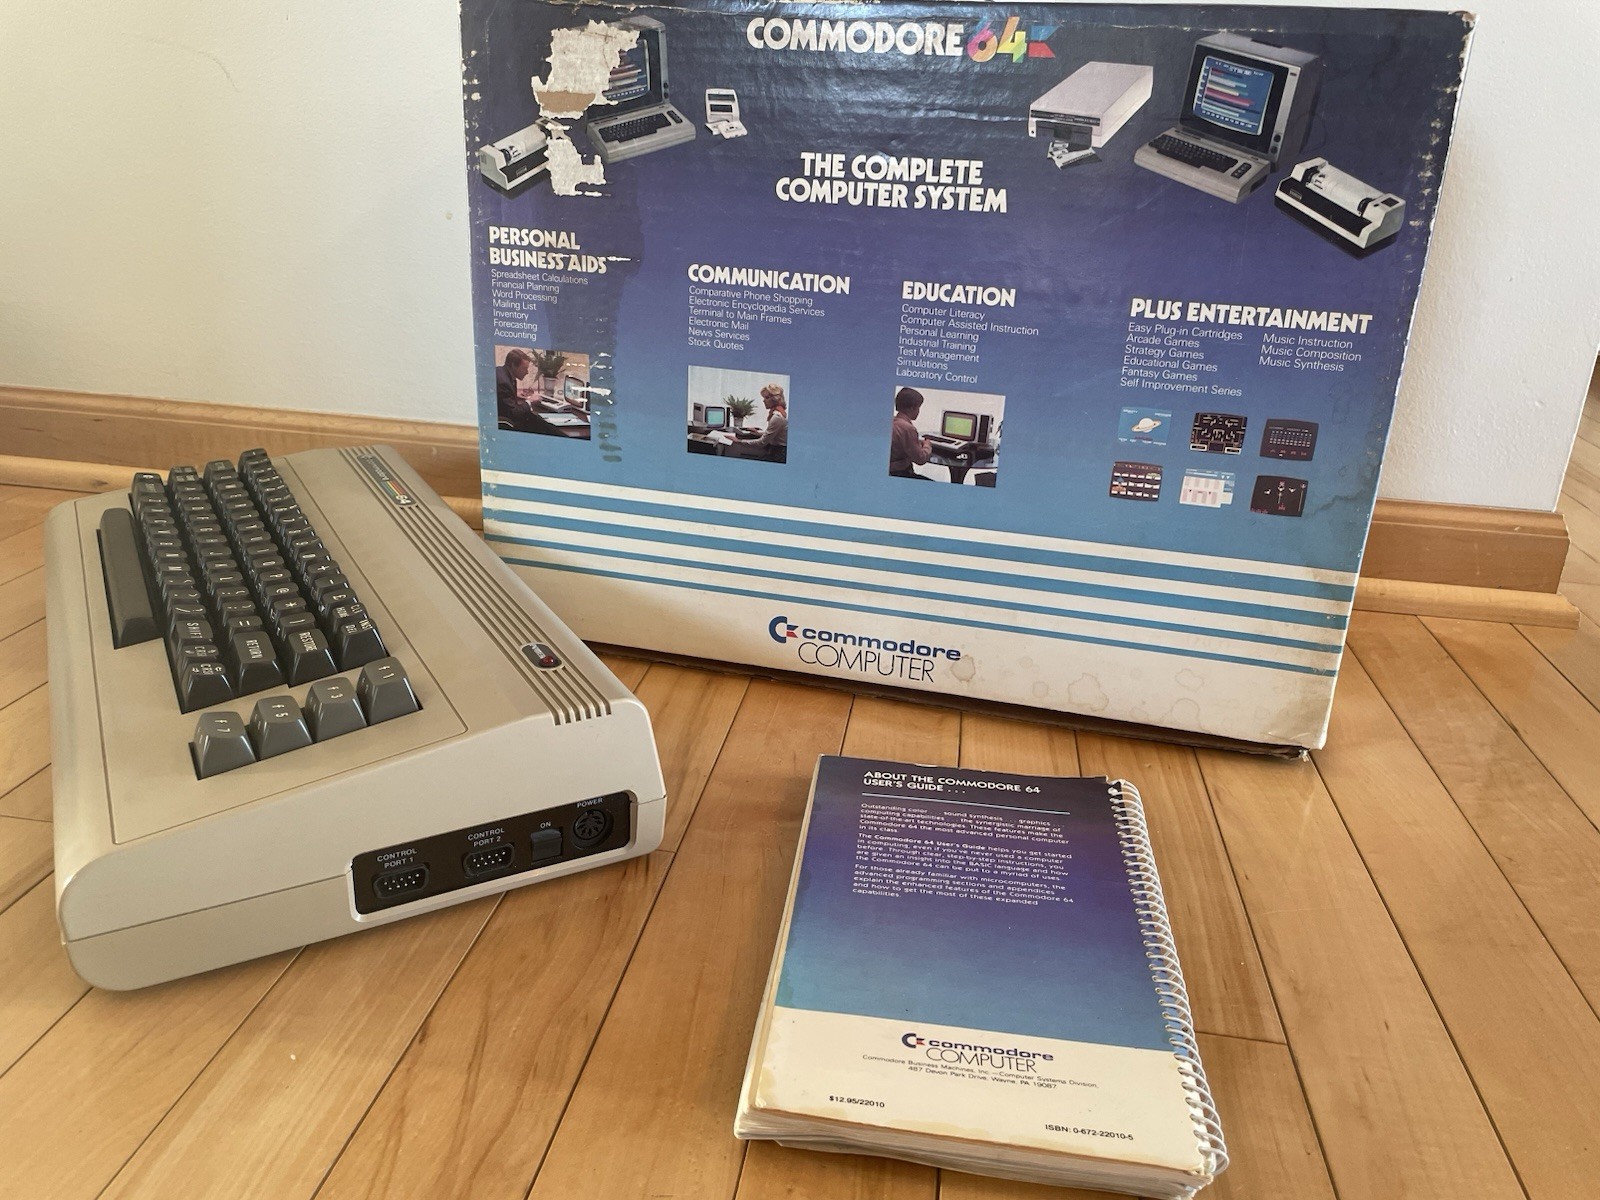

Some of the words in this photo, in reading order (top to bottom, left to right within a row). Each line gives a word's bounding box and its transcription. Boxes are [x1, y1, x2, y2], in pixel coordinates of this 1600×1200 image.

[746, 17, 964, 57] COMMODORE
[966, 16, 1027, 64] 64
[800, 152, 845, 178] THE
[851, 155, 984, 186] COMPLETE
[775, 177, 908, 209] COMPUTER
[913, 185, 1008, 213] SYSTEM
[489, 226, 580, 250] PERSONAL
[489, 248, 564, 270] BUSINESS
[567, 254, 607, 274] AIDS
[491, 269, 540, 281] Spreadsheet
[542, 273, 588, 285] Calculations
[688, 263, 850, 295] COMMUNICATION
[491, 279, 525, 289] Financial
[527, 283, 560, 294] Planning
[902, 281, 1016, 307] EDUCATION
[492, 289, 513, 299] Word
[516, 291, 557, 304] Processing
[493, 299, 520, 310] Mailing
[522, 301, 537, 310] List
[689, 285, 741, 299] Comparative
[744, 290, 771, 302] Phone
[773, 293, 813, 307] Shopping
[493, 309, 529, 320] Inventory
[689, 296, 729, 308] Electronic
[732, 301, 786, 314] Encyclopedia
[789, 306, 825, 317] Services
[901, 303, 947, 316] Computer
[949, 308, 985, 321] Literacy
[689, 306, 723, 318] Terminal
[726, 310, 734, 319] to
[737, 311, 757, 321] Main
[760, 314, 792, 325] Frames
[689, 317, 728, 328] Electronic
[731, 321, 749, 330] Mail
[1130, 298, 1183, 321] PLUS
[1186, 302, 1373, 334] ENTERTAINMENT
[493, 319, 538, 331] Forecasting
[900, 325, 938, 337] Personal
[940, 329, 979, 342] Learning
[901, 314, 945, 327] Computer
[948, 319, 987, 331] Assisted
[990, 323, 1039, 336] Instruction
[1128, 322, 1152, 334] Easy
[1155, 324, 1188, 337] Plug-in
[1191, 327, 1243, 341] Cartridges
[494, 328, 537, 341] Accounting
[688, 327, 712, 338] News
[715, 330, 750, 341] Services
[1126, 333, 1161, 345] Arcade
[1164, 336, 1200, 348] Games
[1263, 333, 1295, 345] Music
[1298, 336, 1353, 349] Instruction
[688, 337, 711, 347] Stock
[714, 340, 744, 351] Quotes
[899, 336, 939, 348] Industrial
[941, 339, 977, 353] Training
[1125, 344, 1166, 358] Strategy
[1168, 347, 1205, 359] Games
[1261, 344, 1293, 357] Music
[1296, 347, 1361, 361] Composition
[898, 346, 917, 356] Test
[919, 348, 979, 362] Management
[897, 357, 948, 370] Simulations
[1123, 355, 1180, 369] Educational
[1182, 360, 1218, 372] Games
[1259, 356, 1291, 368] Music
[1293, 358, 1344, 372] Synthesis
[896, 367, 942, 381] Laboratory
[945, 372, 978, 384] Control
[1121, 366, 1159, 380] Fantasy
[1162, 369, 1198, 381] Games
[1120, 377, 1140, 387] Self
[1142, 379, 1208, 394] Improvement
[1211, 384, 1242, 397] Series
[802, 628, 961, 661] commodore
[798, 641, 935, 683] COMPUTER
[863, 778, 903, 788] USER'S
[907, 781, 944, 791] GUIDE
[864, 771, 907, 781] ABOUT
[911, 774, 934, 784] THE
[938, 777, 1021, 792] COMMODORE
[1025, 785, 1041, 794] 64
[576, 797, 603, 808] POWER
[861, 803, 907, 812] Outstanding
[969, 813, 1003, 821] synthesis
[1018, 819, 1051, 827] graphics
[540, 821, 552, 829] ON
[860, 818, 906, 829] Commodore
[956, 829, 993, 838] advanced
[996, 833, 1029, 842] personal
[1032, 836, 1069, 845] computer
[467, 828, 505, 841] CONTROL
[473, 838, 493, 848] PORT
[874, 834, 922, 845] Commodore
[988, 845, 1010, 853] helps
[376, 848, 418, 862] CONTROL
[384, 858, 406, 869] PORT
[854, 870, 894, 879] advanced
[896, 874, 951, 885] programming
[952, 880, 986, 888] sections
[1006, 885, 1055, 895] appendices
[895, 868, 926, 876] already
[927, 871, 957, 879] familiar
[960, 873, 978, 881] with
[929, 1040, 1054, 1061] commodore
[862, 1054, 906, 1064] Commodore
[908, 1060, 939, 1069] Business
[999, 1071, 1034, 1081] Computer
[1037, 1075, 1066, 1084] Systems
[926, 1047, 1037, 1074] COMPUTER
[925, 1068, 948, 1076] Devon
[1045, 1124, 1071, 1133] ISBN:
[1072, 1127, 1134, 1140] 0-672-22010-5
